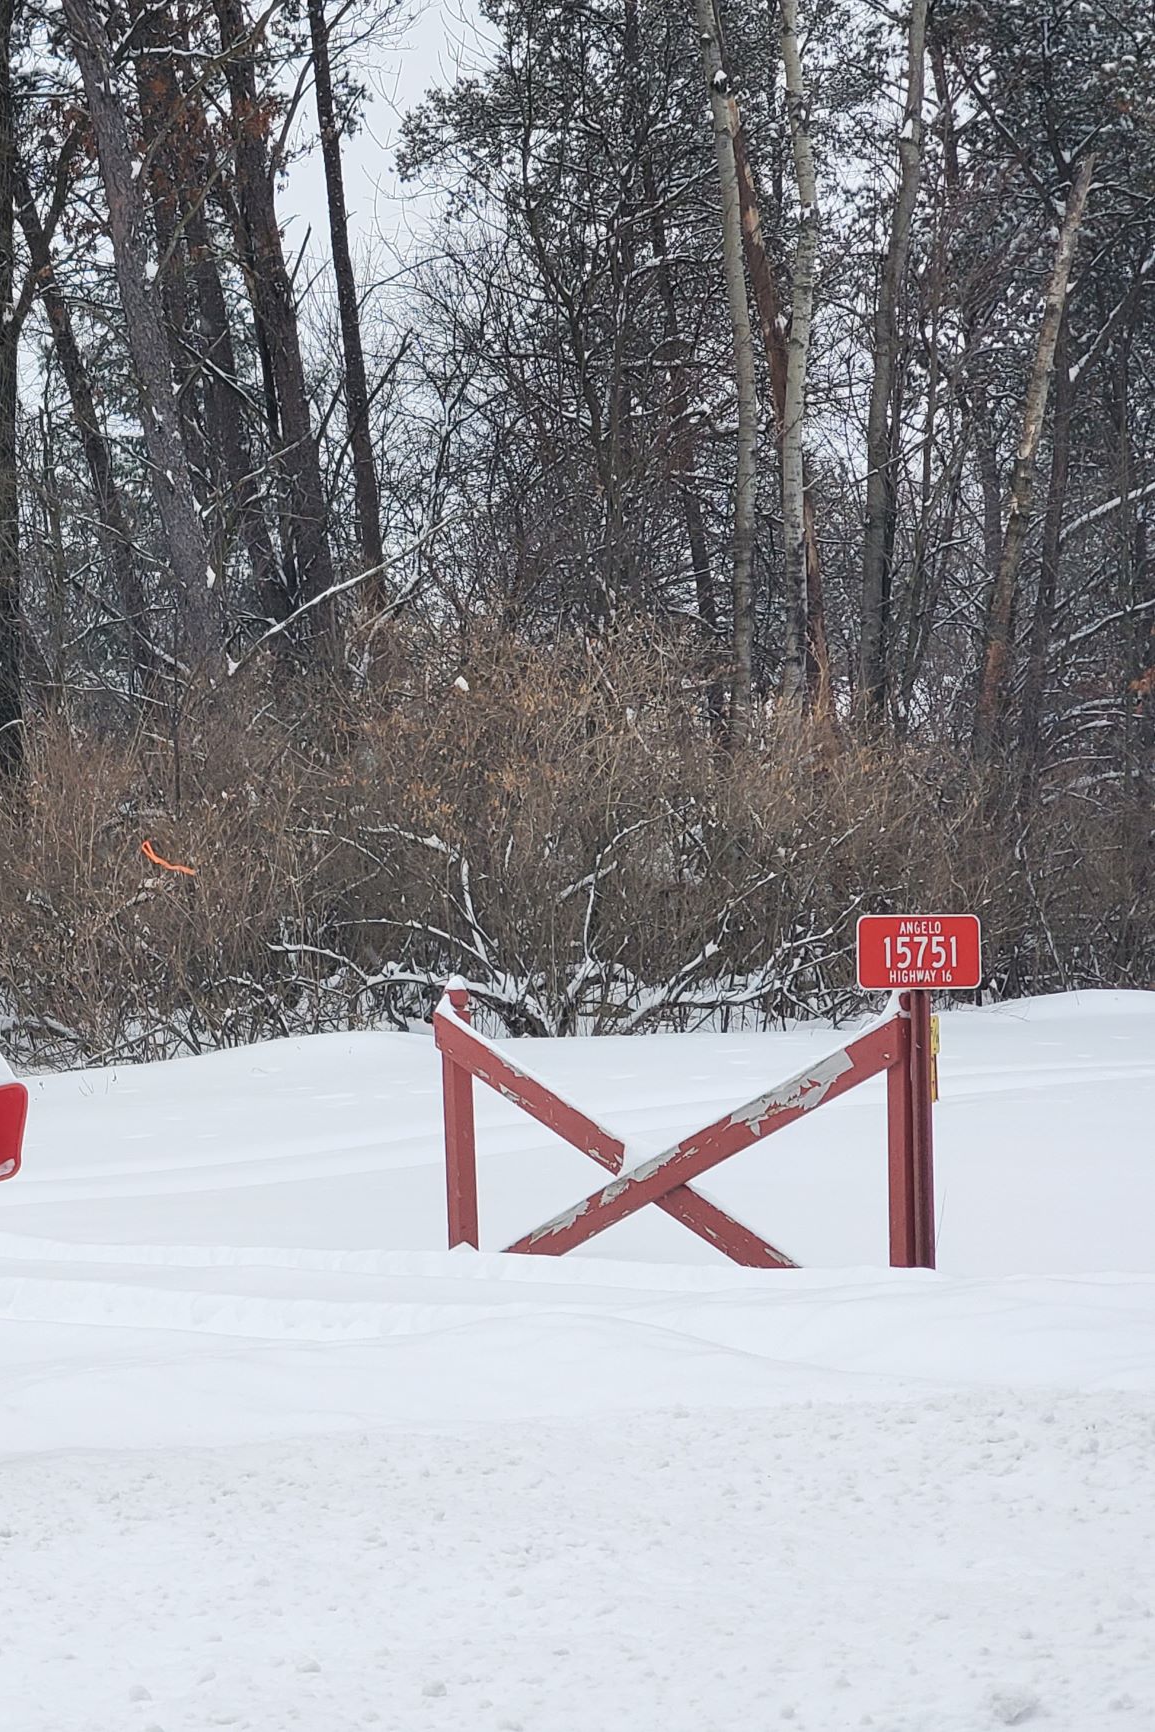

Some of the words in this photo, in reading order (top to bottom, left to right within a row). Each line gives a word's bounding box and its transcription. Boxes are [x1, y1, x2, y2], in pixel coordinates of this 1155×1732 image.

[899, 921, 941, 935] ANGELO
[883, 936, 957, 969] 15751
[889, 969, 937, 983] HIGHWAY
[942, 970, 952, 982] 16
